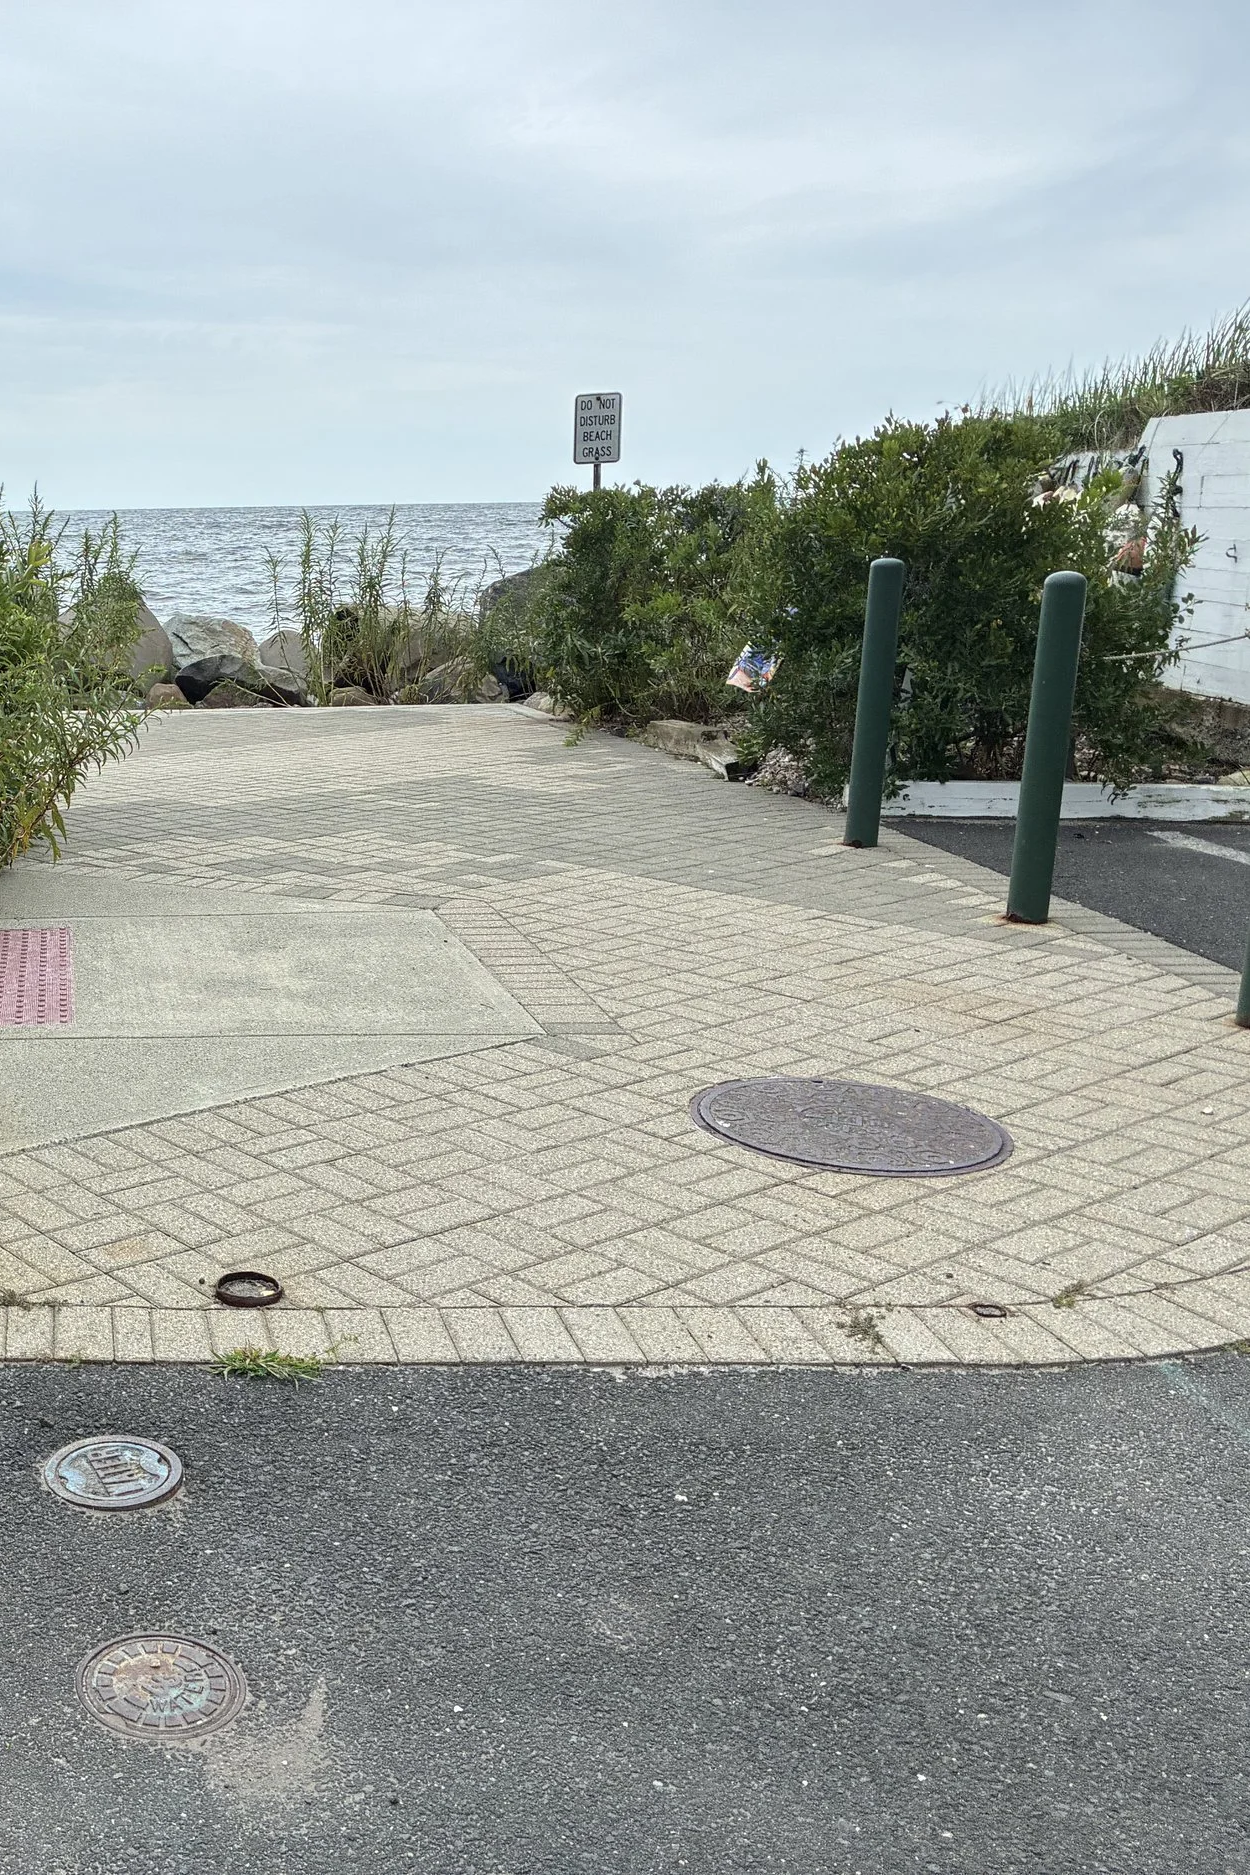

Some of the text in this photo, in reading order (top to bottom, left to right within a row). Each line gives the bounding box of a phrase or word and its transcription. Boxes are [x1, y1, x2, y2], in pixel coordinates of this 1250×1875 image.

[580, 398, 616, 411] DO NOT
[579, 414, 616, 427] DISTURB
[582, 430, 612, 442] BEACH
[582, 446, 612, 458] GRASS
[148, 1672, 205, 1713] WATER
